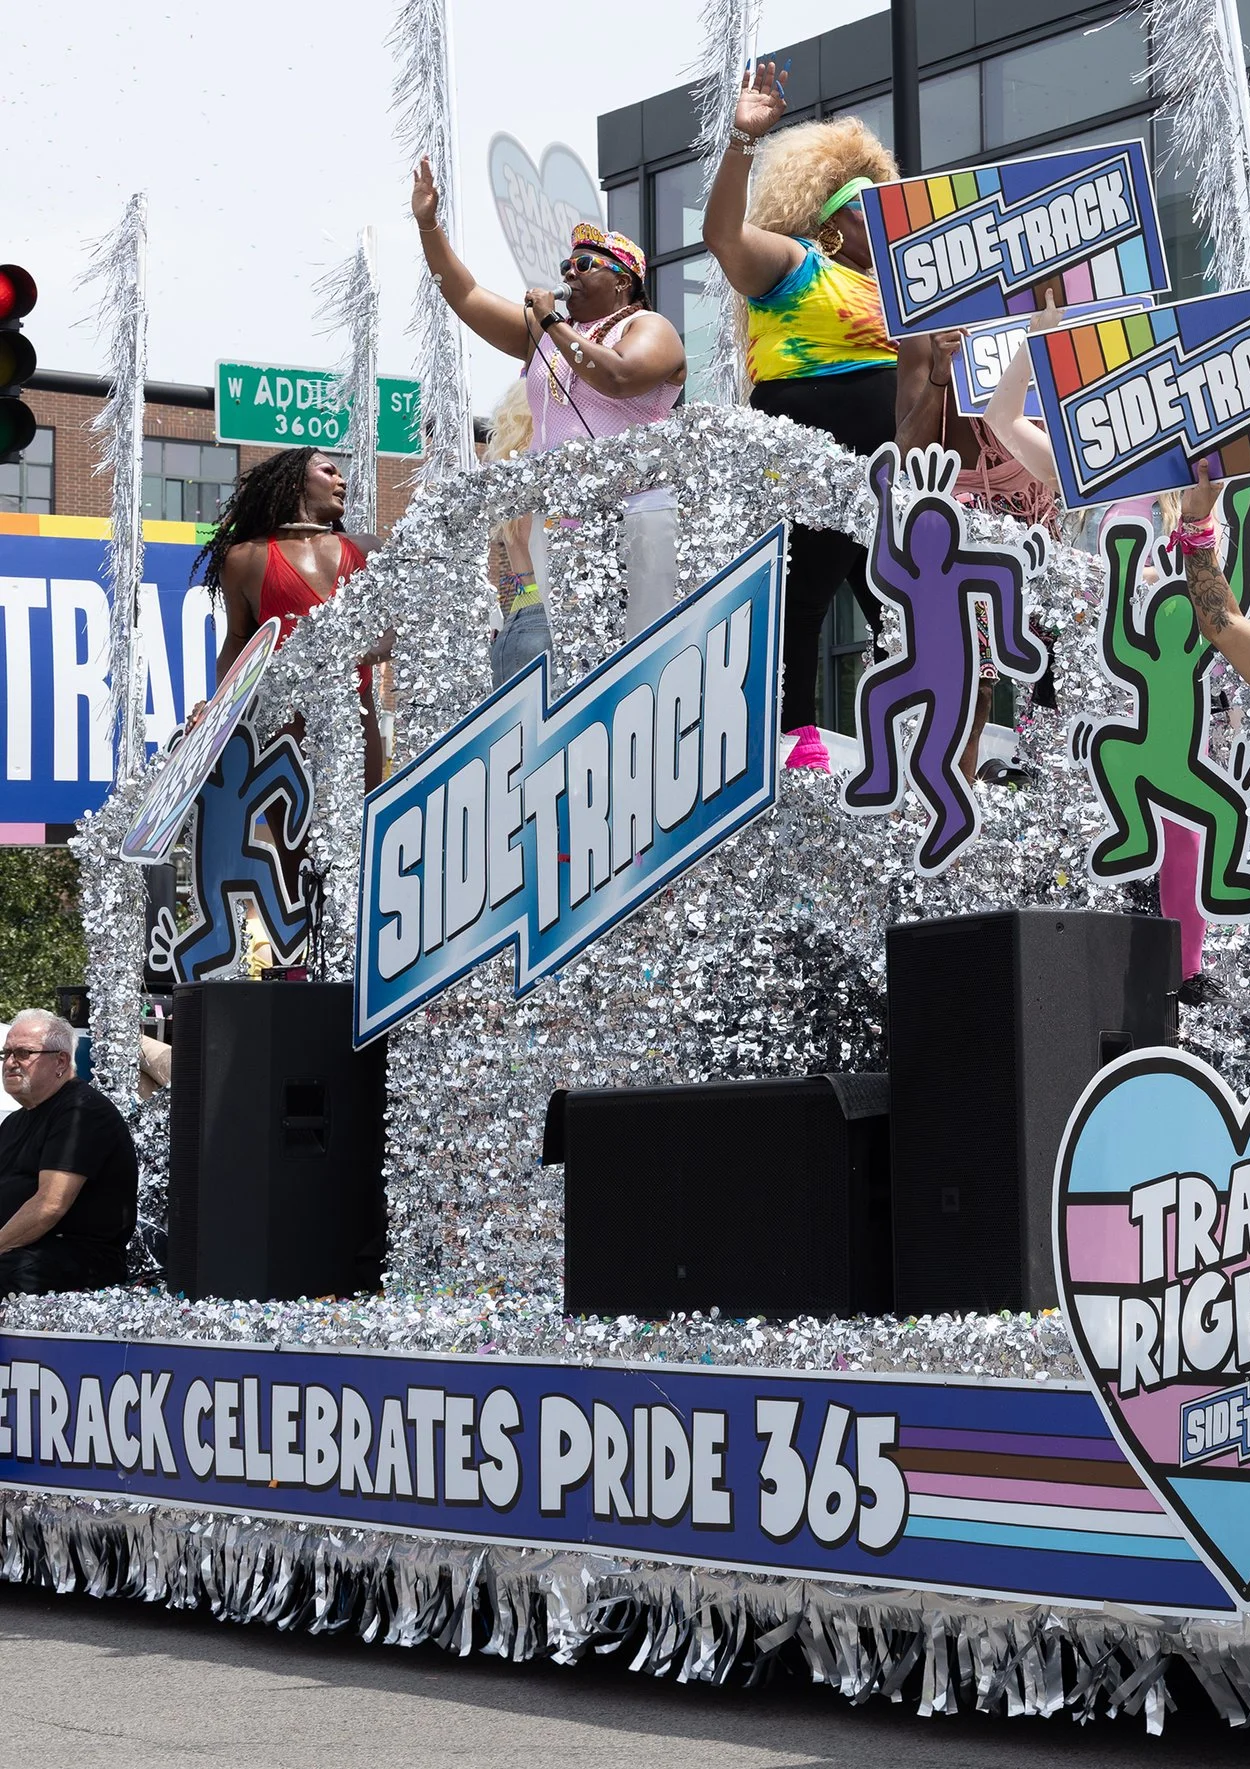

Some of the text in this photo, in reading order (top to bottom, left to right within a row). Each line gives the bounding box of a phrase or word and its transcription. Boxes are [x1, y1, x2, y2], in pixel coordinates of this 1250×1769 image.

[903, 168, 1134, 303] SIDETRACK
[228, 376, 413, 417] W ADDIS ST
[275, 414, 340, 439] 3600
[0, 576, 229, 781] TRAC
[378, 598, 753, 983] SIDETRACK
[182, 1376, 520, 1508] CELEBRATES
[540, 1395, 732, 1527] PRIDE
[756, 1401, 907, 1552] 365
